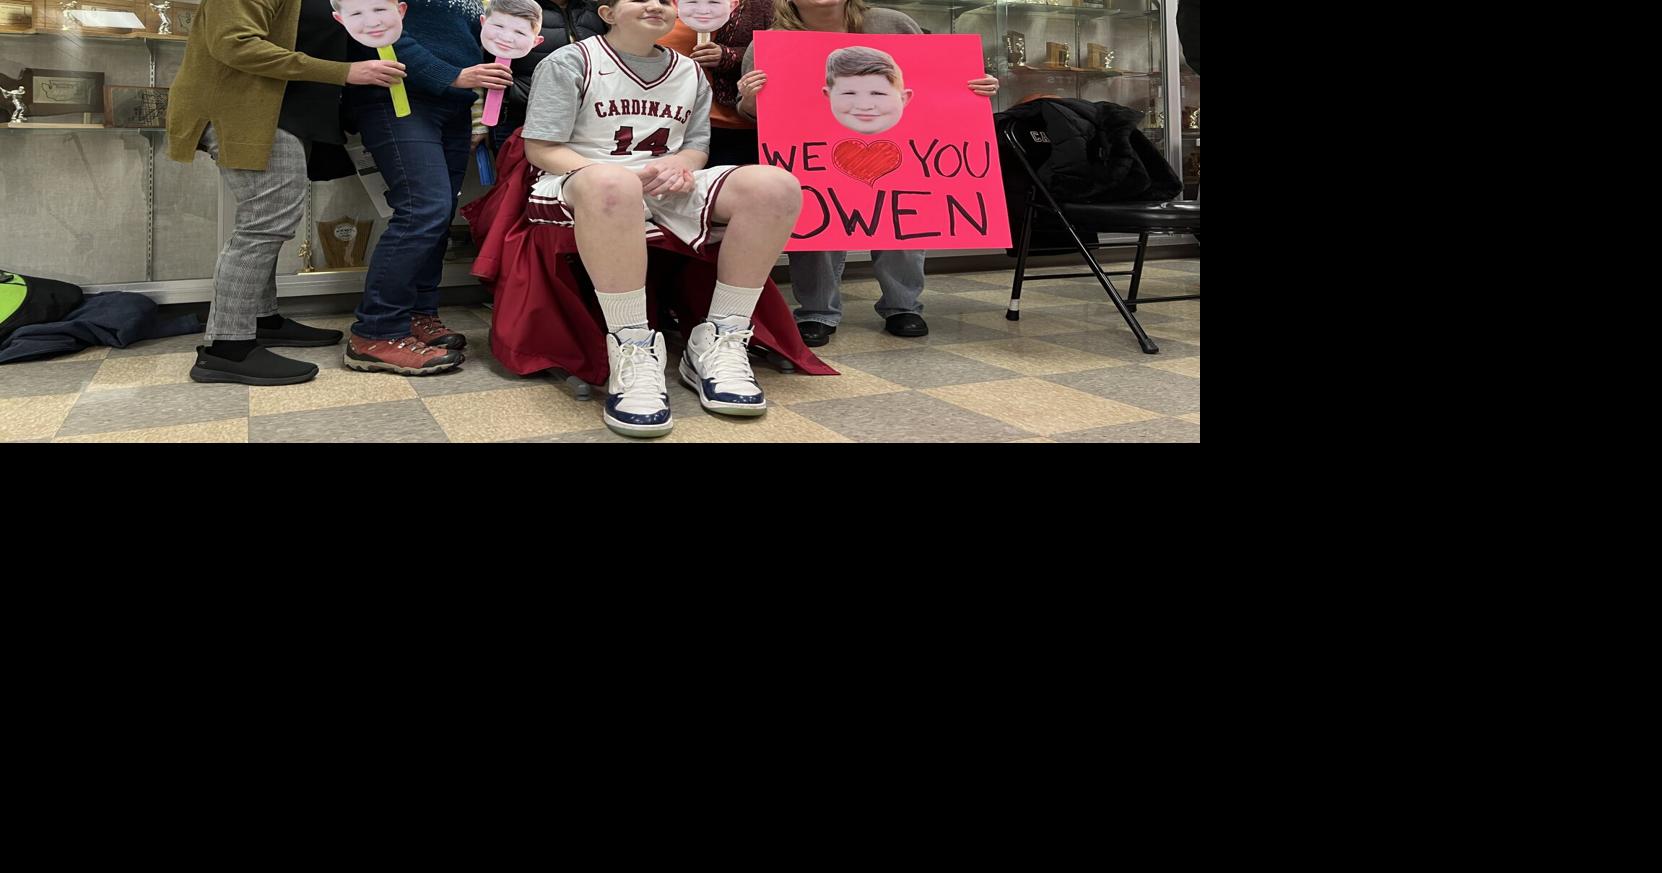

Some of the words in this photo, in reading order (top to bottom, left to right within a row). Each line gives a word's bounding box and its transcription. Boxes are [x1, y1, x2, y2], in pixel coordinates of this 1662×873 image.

[594, 99, 692, 125] CARDINALS
[610, 125, 671, 157] 14
[762, 141, 828, 173] WE
[908, 138, 991, 179] YOU
